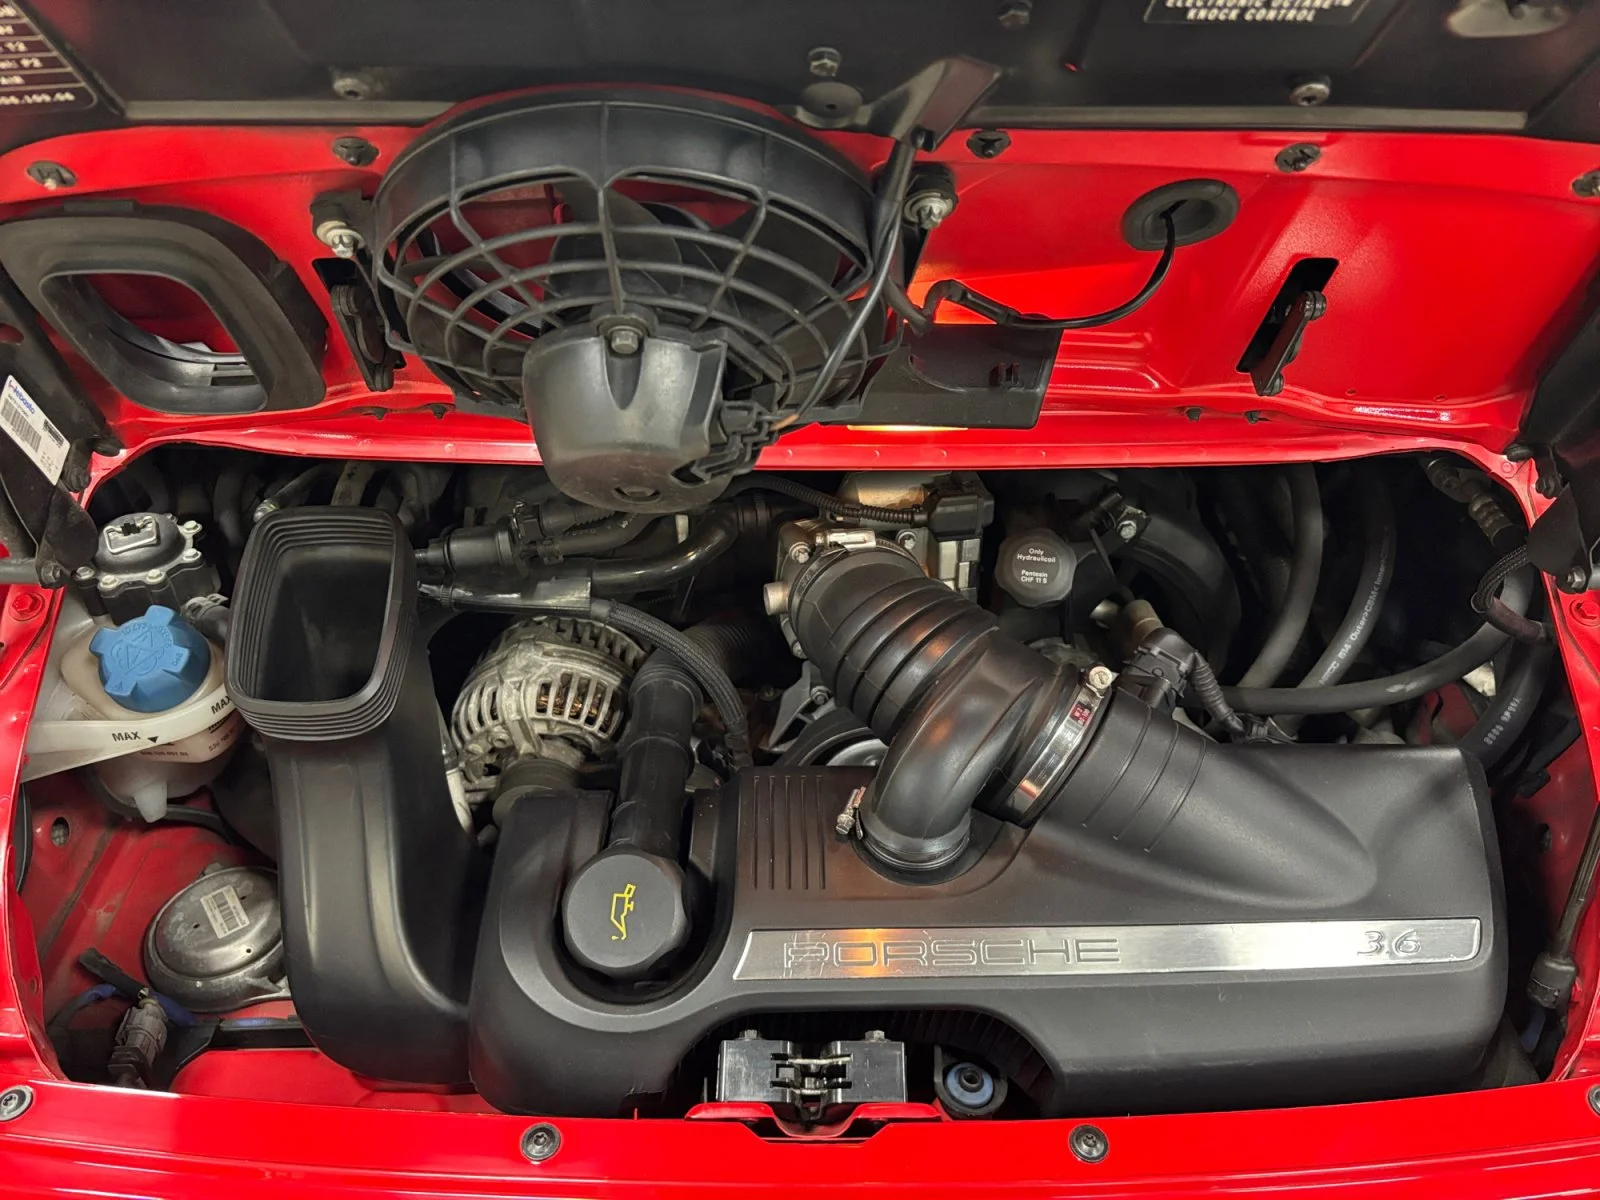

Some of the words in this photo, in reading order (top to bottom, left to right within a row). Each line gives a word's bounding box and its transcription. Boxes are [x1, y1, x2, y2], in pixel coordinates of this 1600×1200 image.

[1186, 8, 1240, 21] KNOCK
[1244, 8, 1316, 22] CONTROL
[1028, 547, 1044, 556] Only
[1016, 553, 1056, 563] Hydraulicoil
[1021, 569, 1048, 577] Pentosin
[112, 731, 141, 742] MAX
[784, 938, 1122, 968] PORSCHE
[1356, 928, 1421, 957] 3.6
